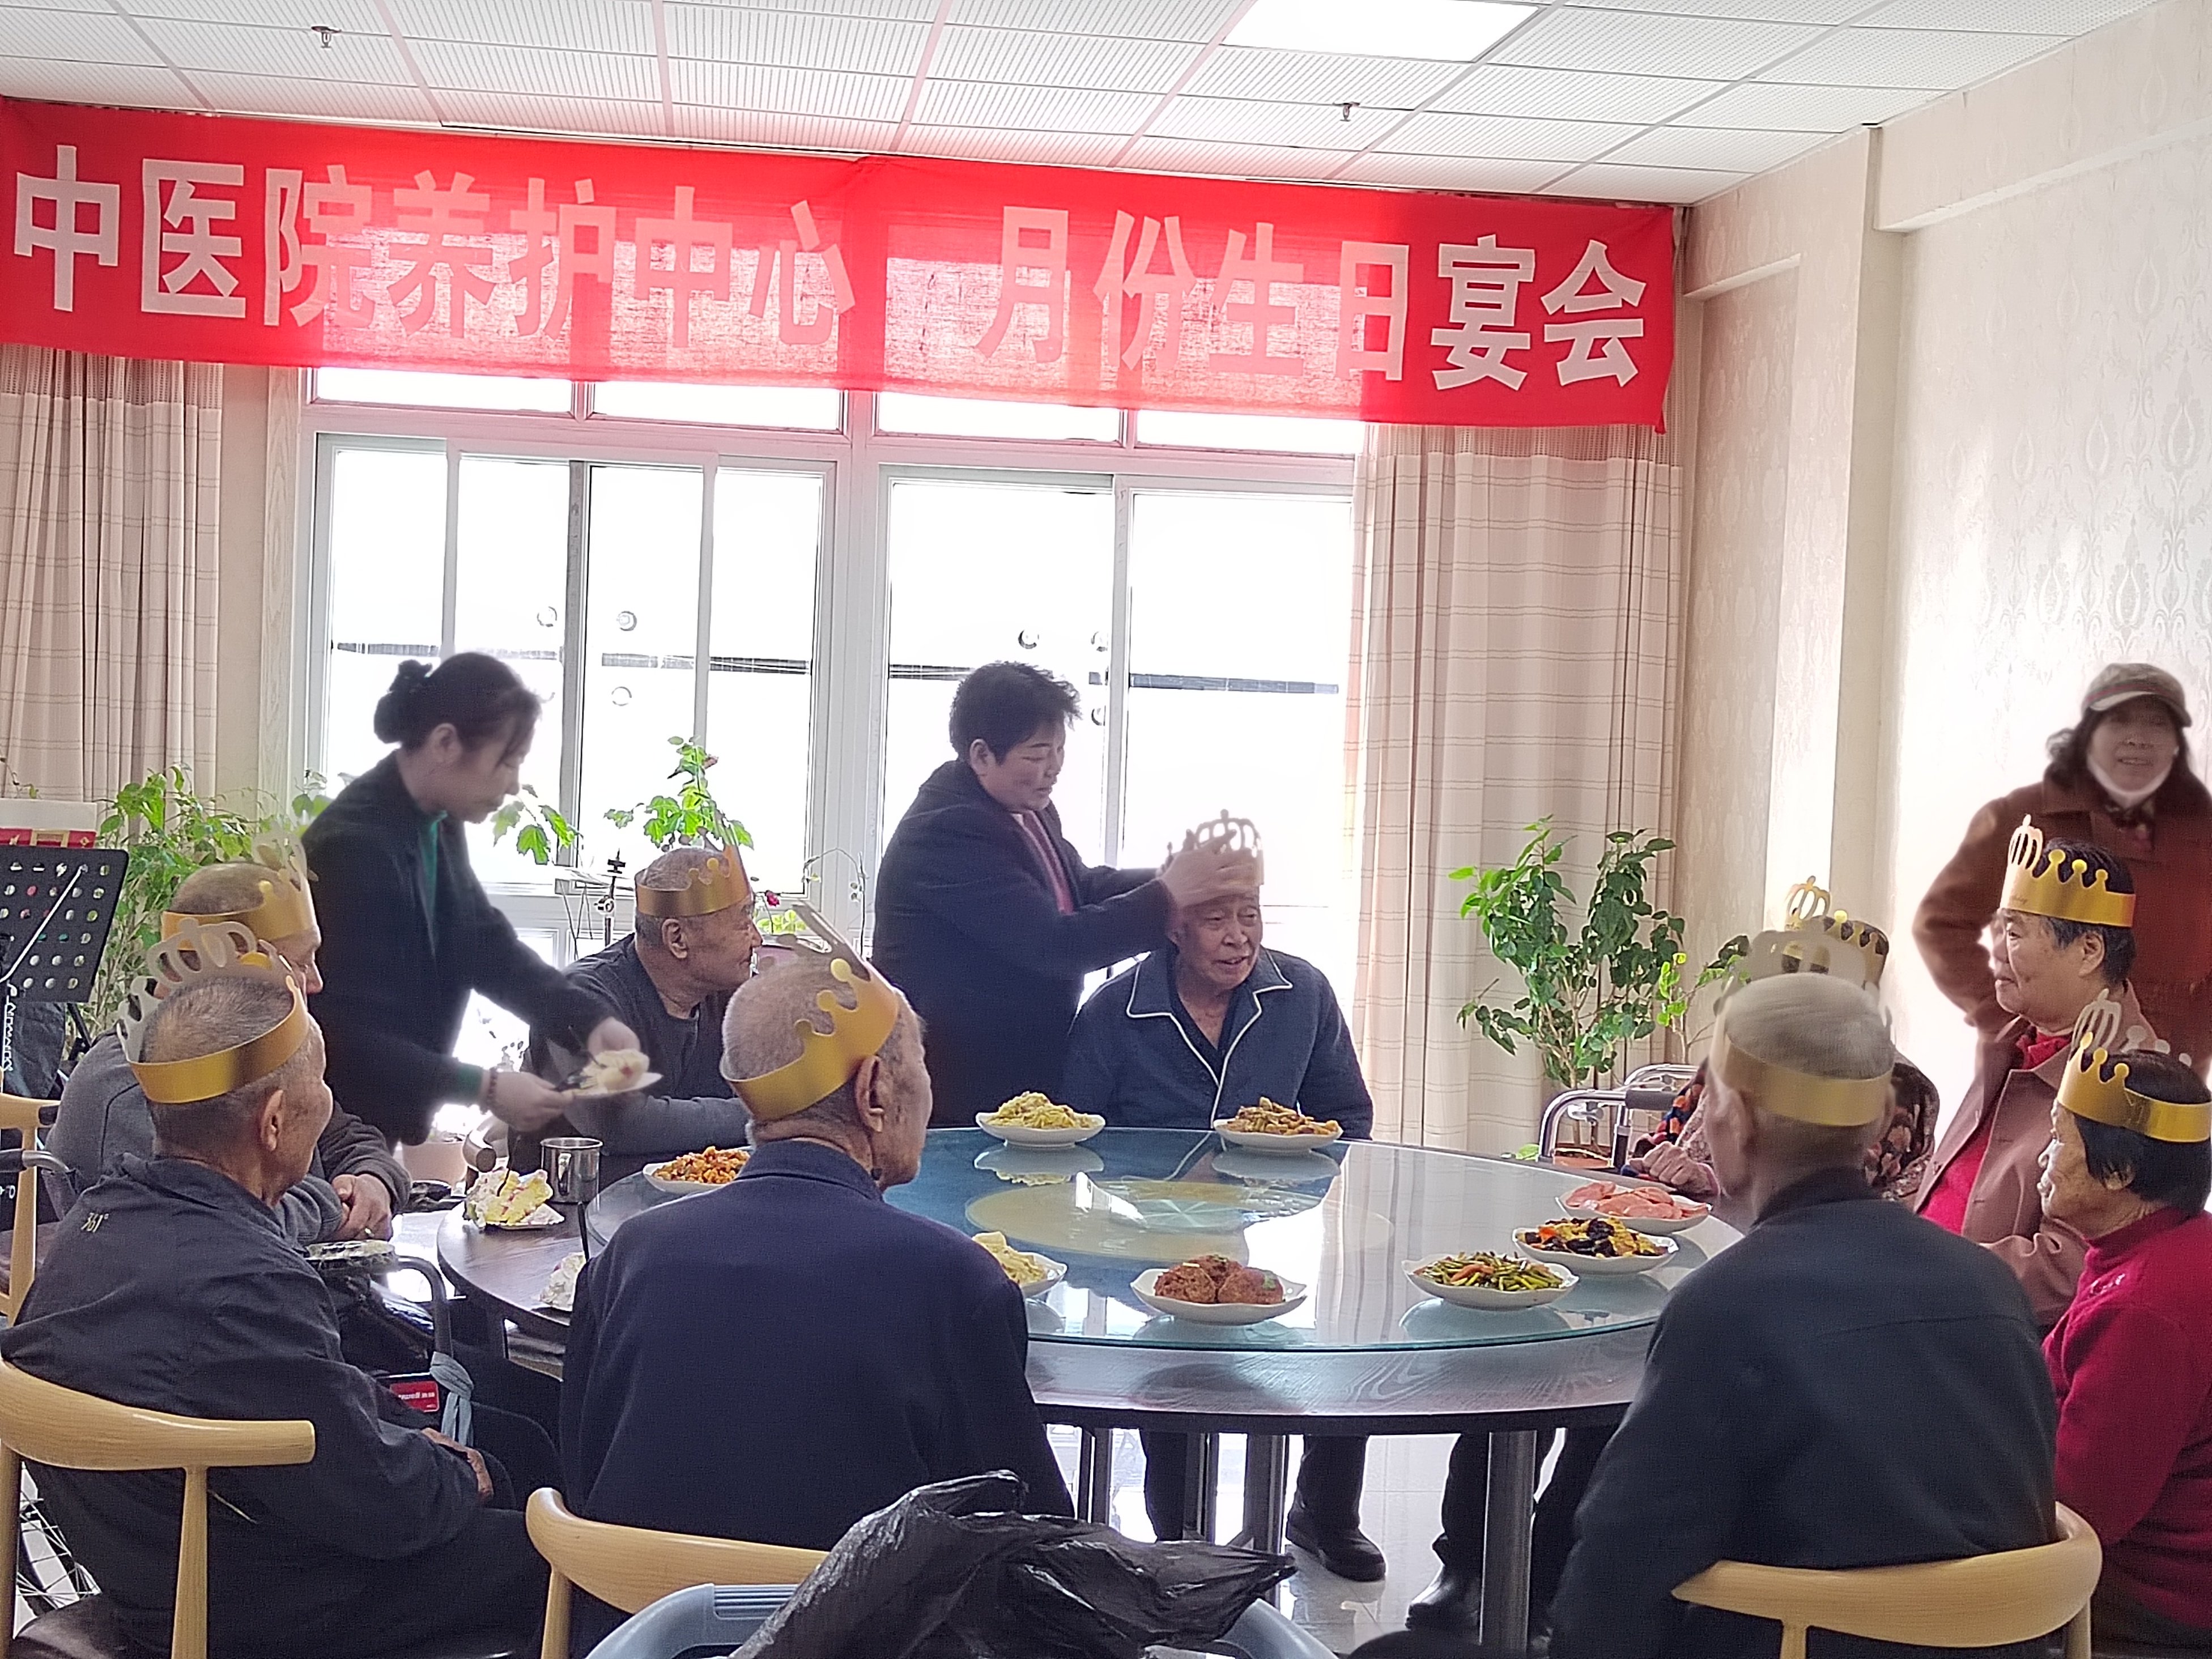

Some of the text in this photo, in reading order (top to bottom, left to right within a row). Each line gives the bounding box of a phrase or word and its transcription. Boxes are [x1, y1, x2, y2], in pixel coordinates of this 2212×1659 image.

[14, 144, 1647, 391] 中医院养护中心 月份生日宴会
